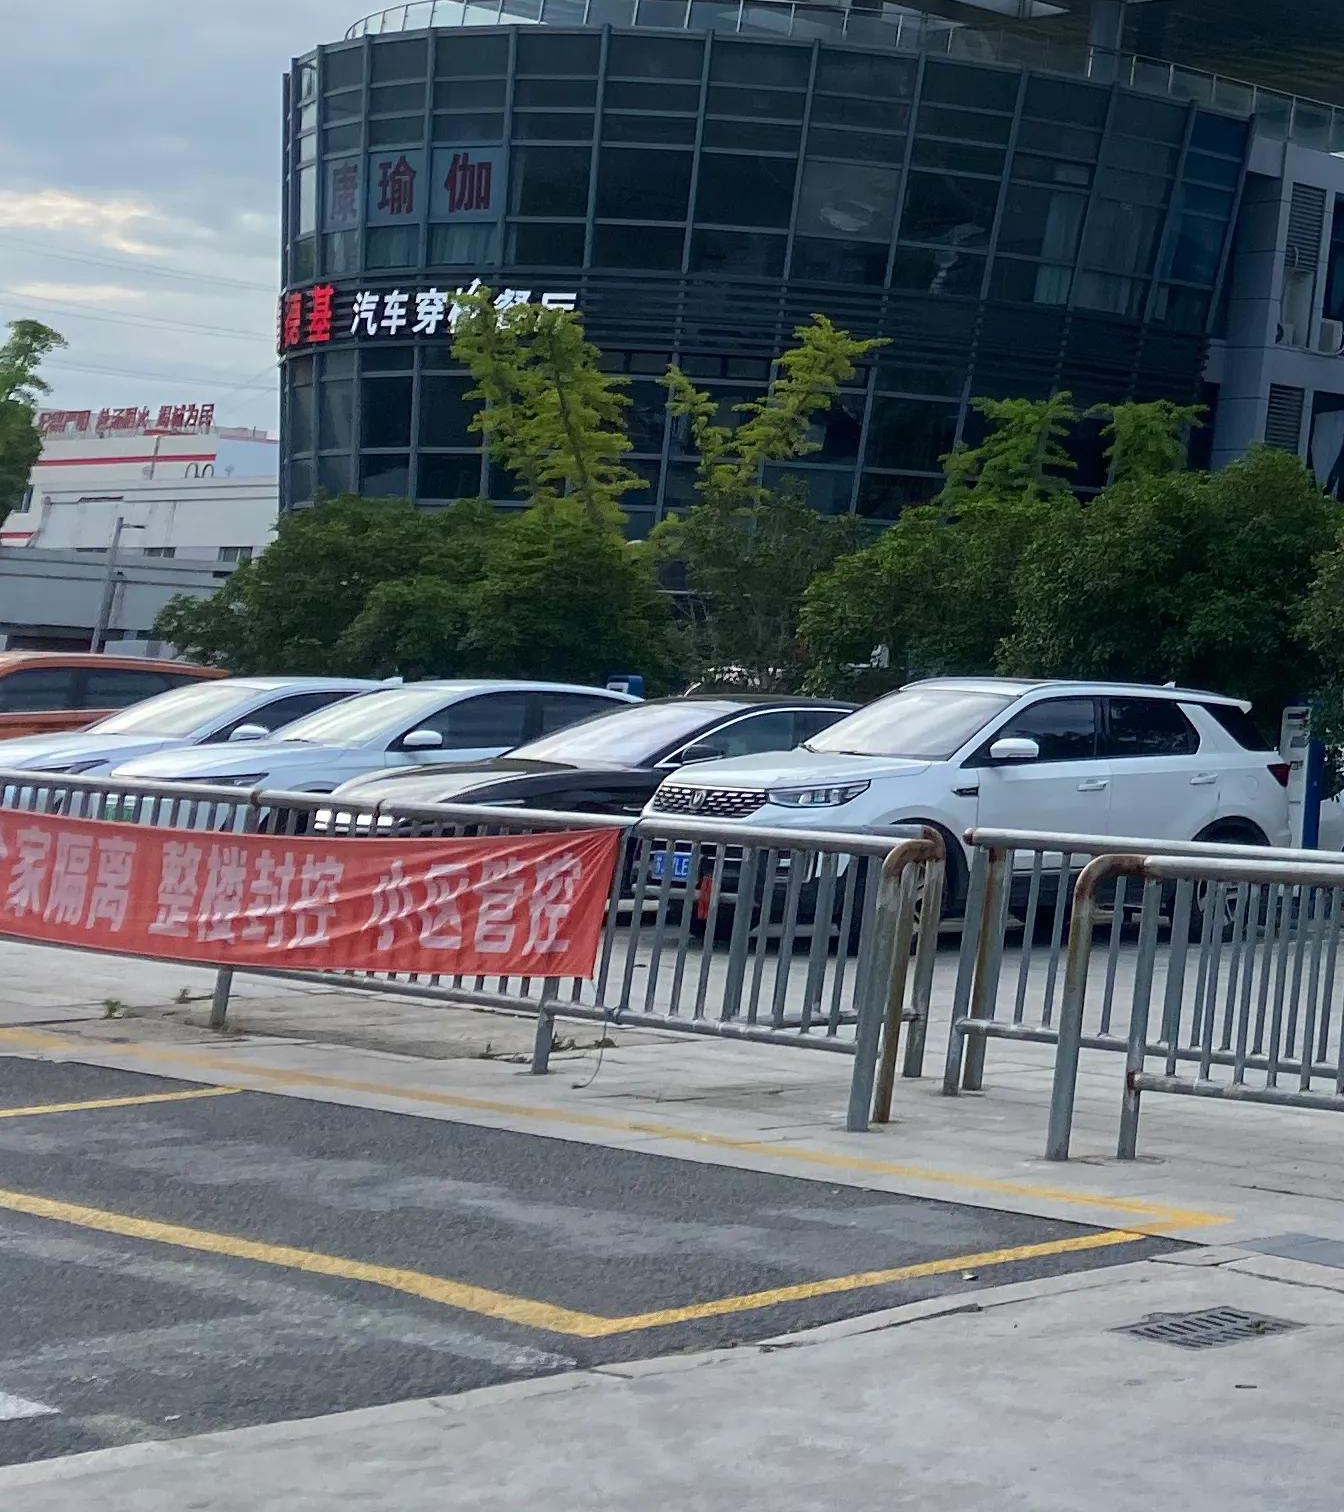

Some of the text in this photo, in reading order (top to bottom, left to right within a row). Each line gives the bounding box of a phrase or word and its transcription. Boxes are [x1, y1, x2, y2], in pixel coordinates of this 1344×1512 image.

[277, 284, 334, 346] 德基
[0, 826, 584, 955] 家隔离 整楼封控 小区管控
